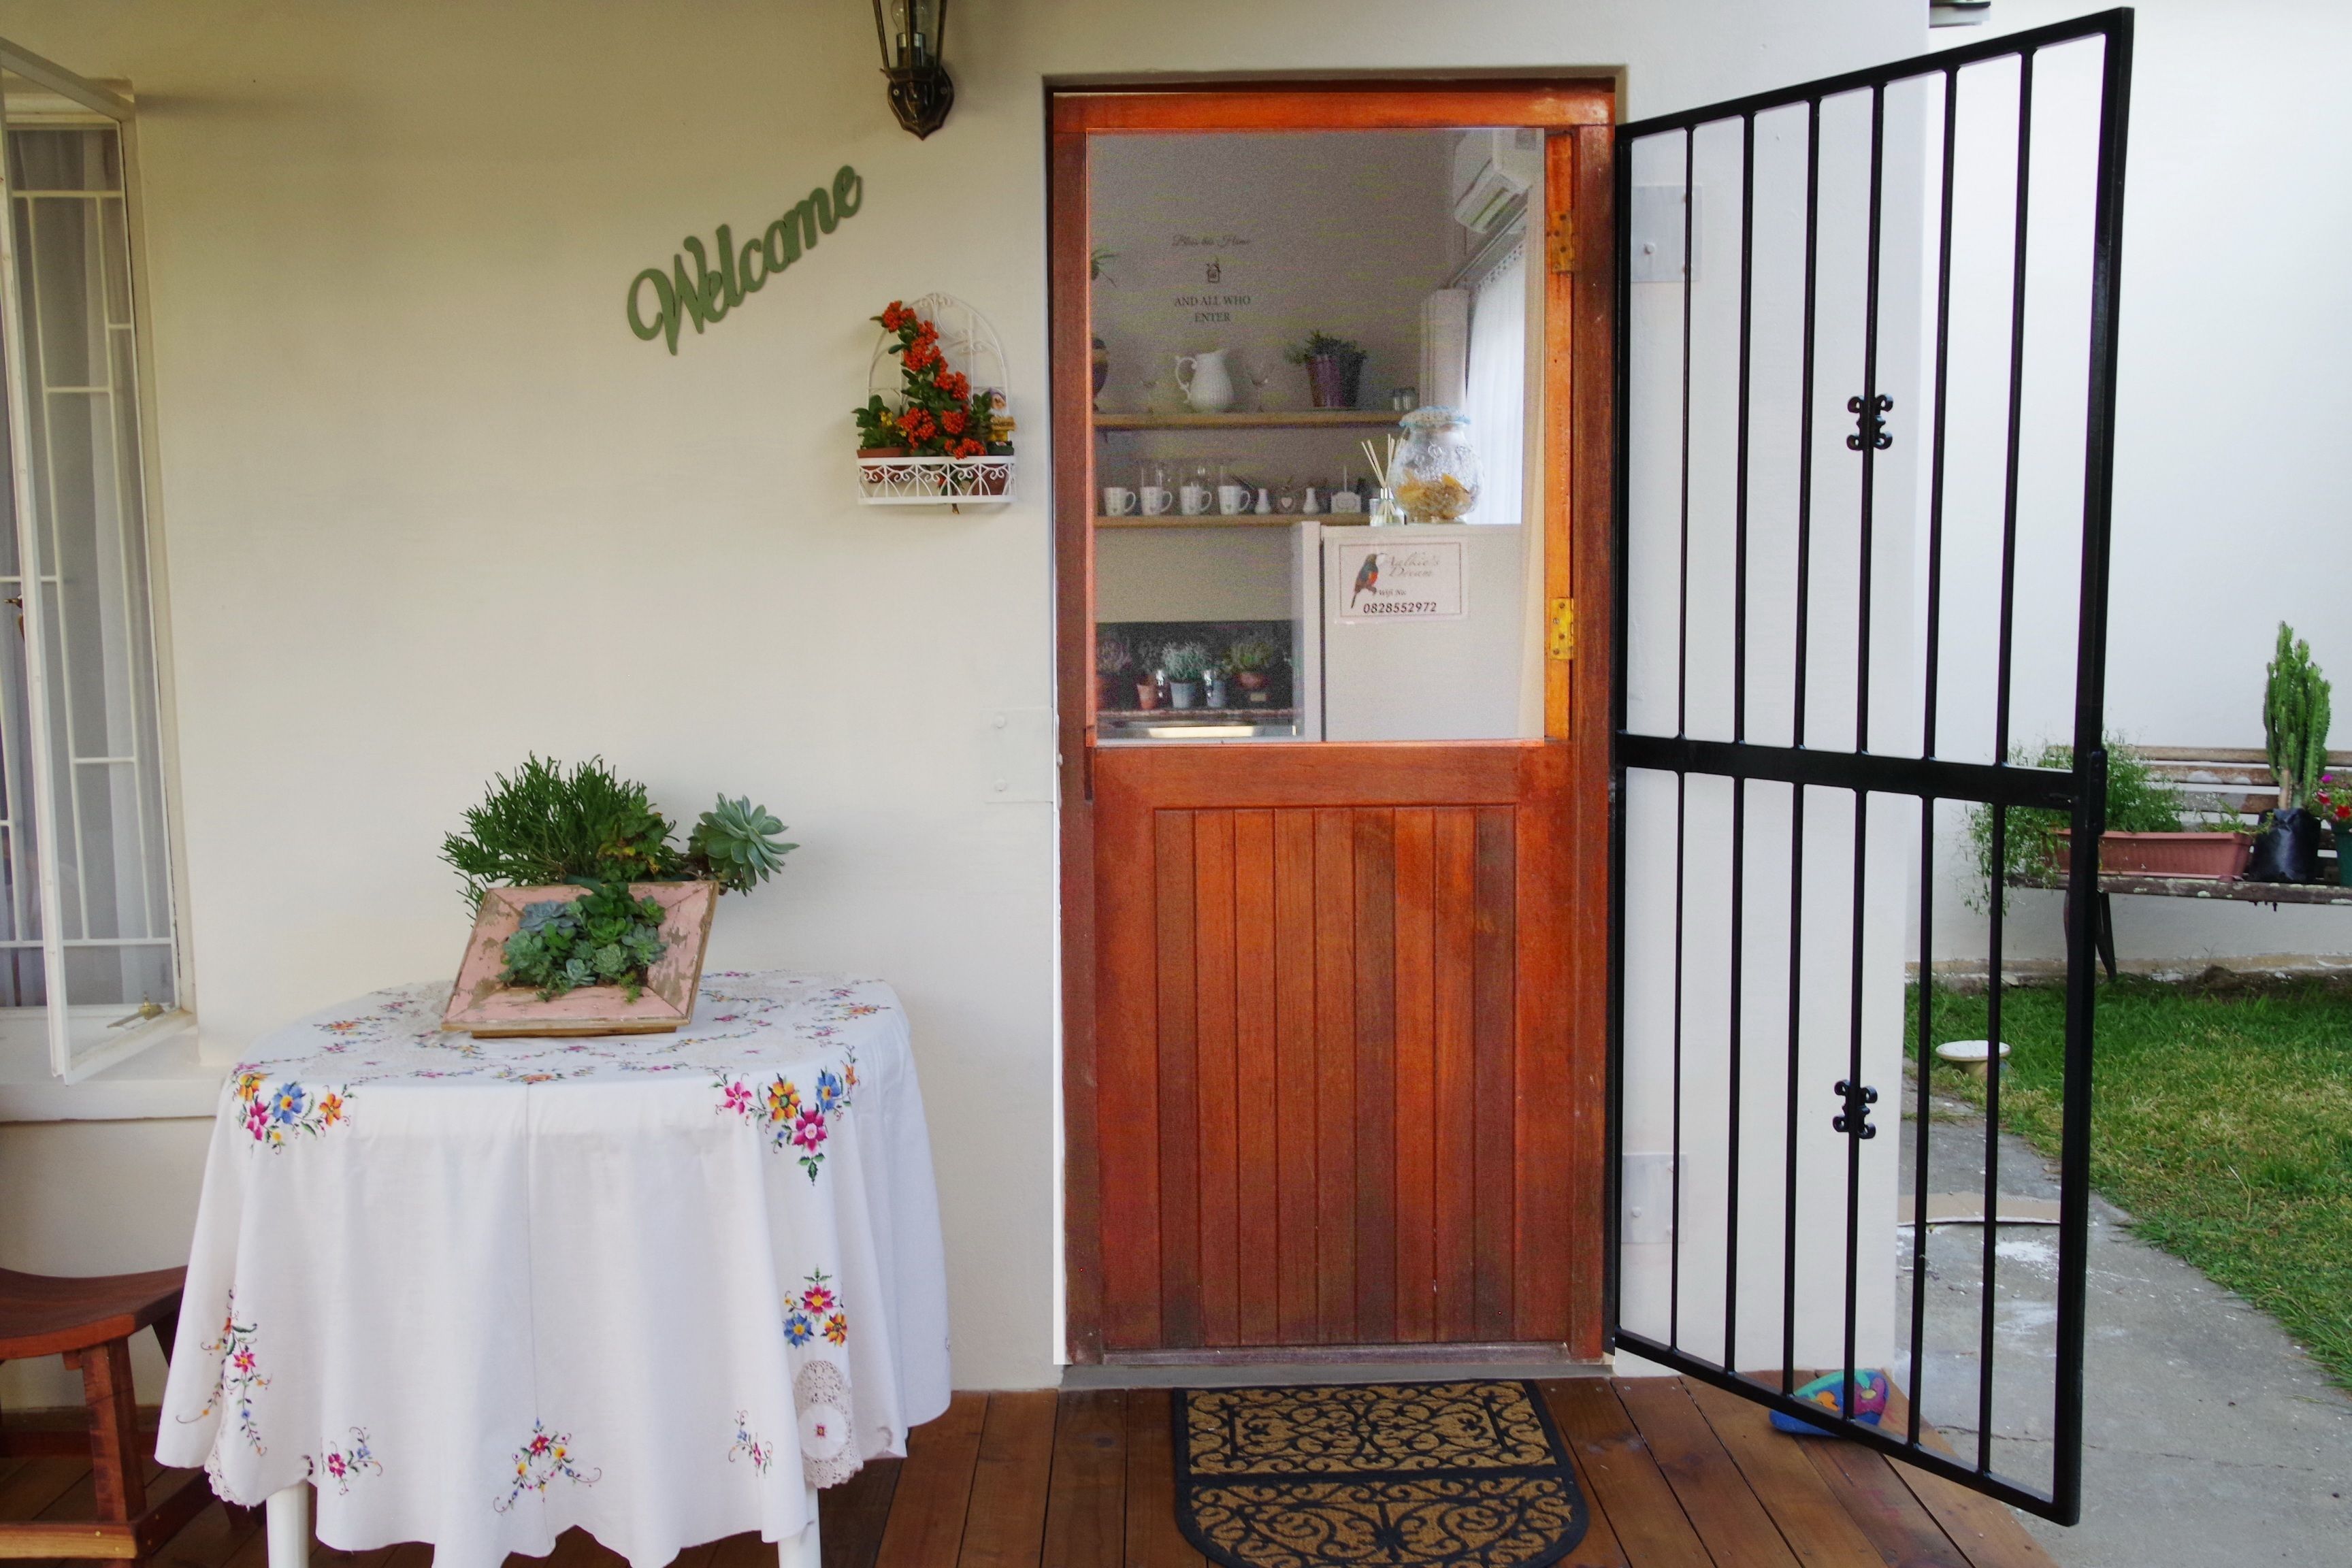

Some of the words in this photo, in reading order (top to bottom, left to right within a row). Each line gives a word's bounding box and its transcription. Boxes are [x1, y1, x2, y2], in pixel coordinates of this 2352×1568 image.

[627, 165, 862, 356] Welcome
[1175, 296, 1198, 306] AND
[1200, 295, 1220, 306] ALL
[1223, 295, 1251, 306] WHO
[1194, 312, 1230, 323] ENTER
[1363, 602, 1437, 613] 0828552972
